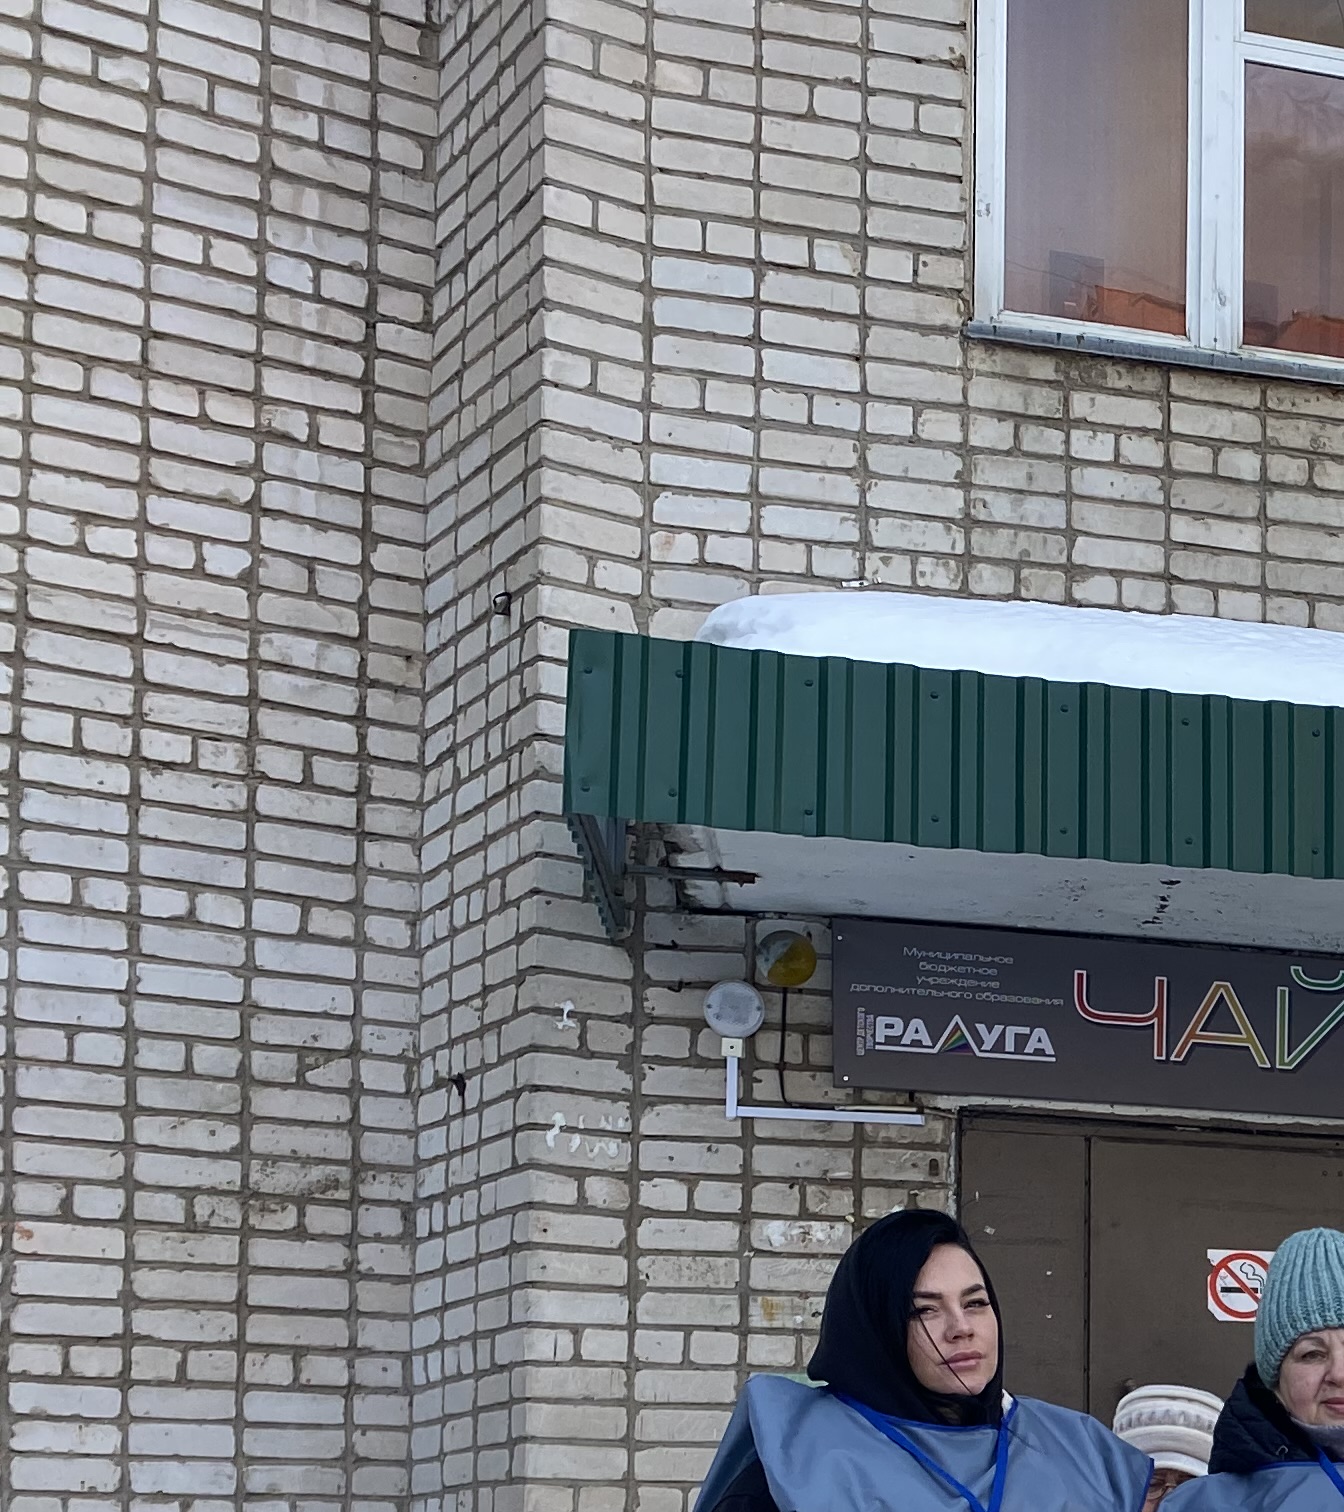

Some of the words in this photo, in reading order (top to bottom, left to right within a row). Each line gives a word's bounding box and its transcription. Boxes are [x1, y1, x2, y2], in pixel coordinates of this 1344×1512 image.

[902, 946, 1014, 965] Муниципальное
[918, 961, 998, 976] бюджетное
[916, 975, 1001, 989] учреждение
[849, 983, 973, 999] дополнительного
[975, 992, 1064, 1006] образования
